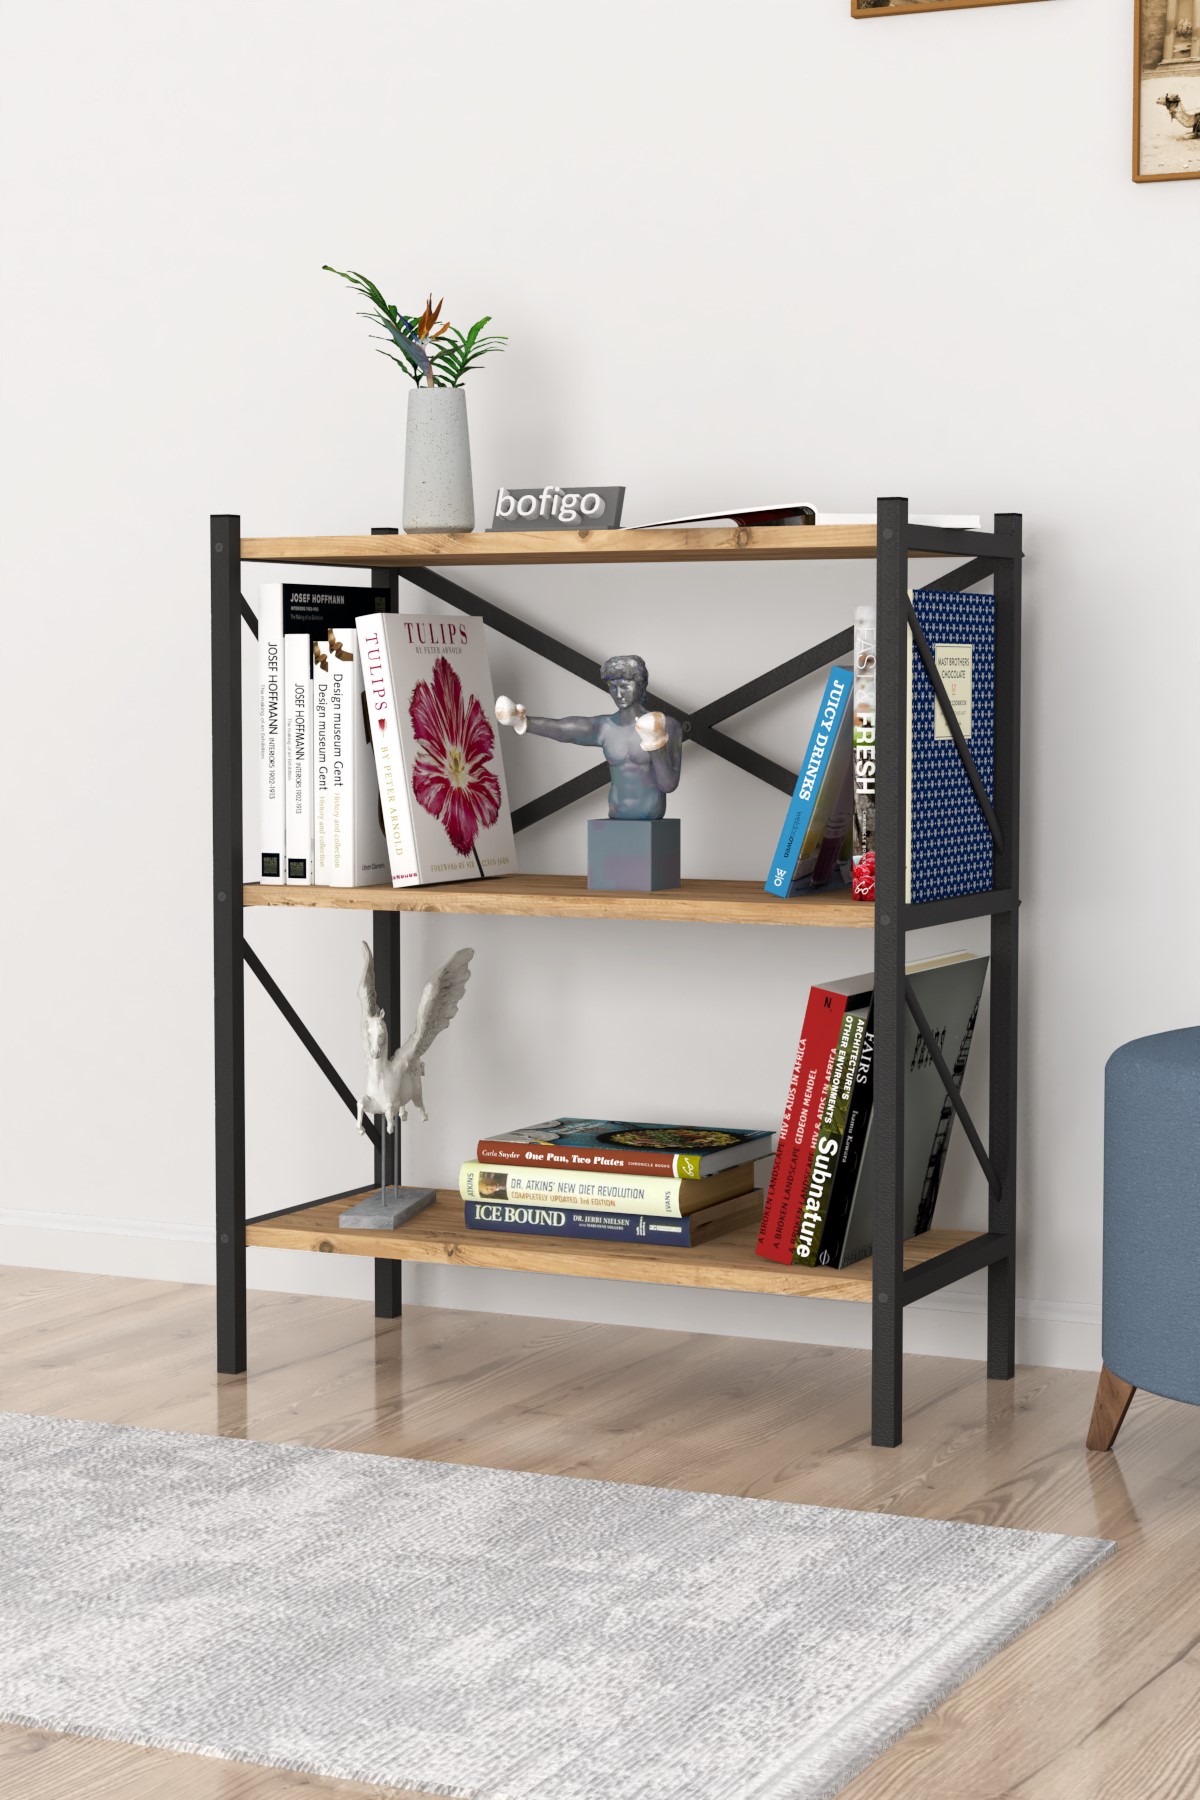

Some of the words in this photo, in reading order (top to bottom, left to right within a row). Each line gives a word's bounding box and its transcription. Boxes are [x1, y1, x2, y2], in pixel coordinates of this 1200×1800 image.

[495, 486, 602, 524] bofigo
[290, 593, 310, 603] JOSEF
[312, 594, 344, 604] HOFFMANN
[404, 622, 468, 644] TULIPS
[268, 642, 278, 672] JOSEF
[366, 632, 387, 711] TULIPS
[268, 675, 278, 734] HOFFMANN
[295, 683, 305, 708] JOSEF
[316, 684, 328, 718] Design
[331, 674, 343, 709] Design
[820, 680, 844, 732] JUICY
[295, 710, 305, 760] HOFFMANN
[381, 746, 390, 760] BY
[798, 733, 829, 801] DRINKS
[856, 712, 876, 795] FRESH
[319, 766, 328, 790] Gent
[334, 761, 343, 787] Gent
[384, 765, 396, 802] PETER
[389, 807, 403, 856] ARNOLD
[839, 1016, 853, 1048] OTHER
[794, 1038, 807, 1073] AFRICA
[842, 1018, 864, 1100] ARCHITECTURE'S
[792, 1074, 800, 1086] IN
[825, 1050, 846, 1124] ENVIRONMENTS
[786, 1087, 797, 1110] AIDS
[779, 1122, 789, 1140] HIV
[811, 1131, 819, 1149] HIV
[498, 1151, 520, 1159] Snyder
[525, 1152, 544, 1161] One
[547, 1153, 569, 1163] Pan,
[572, 1155, 591, 1164] Two
[594, 1156, 624, 1166] Plates
[768, 1142, 786, 1196] LANDSCAPE
[775, 1203, 788, 1240] BROKEN
[782, 1148, 800, 1200] LANDSCAPE
[795, 1108, 809, 1145] GIDEON
[802, 1069, 818, 1106] MENDEL
[511, 1179, 524, 1189] DR.
[526, 1180, 555, 1192] ATKINS'
[558, 1182, 576, 1194] NEW
[579, 1184, 595, 1195] DIET
[598, 1186, 644, 1199] REVOLUTION
[511, 1191, 548, 1201] COMPLETELY
[550, 1194, 577, 1203] UPDATED
[591, 1198, 616, 1207] EDITION
[796, 1136, 838, 1258] Subnature
[475, 1204, 502, 1221] ICE
[504, 1206, 566, 1226] BOUND
[603, 1217, 630, 1226] NIELSEN
[760, 1199, 773, 1235] BROKEN
